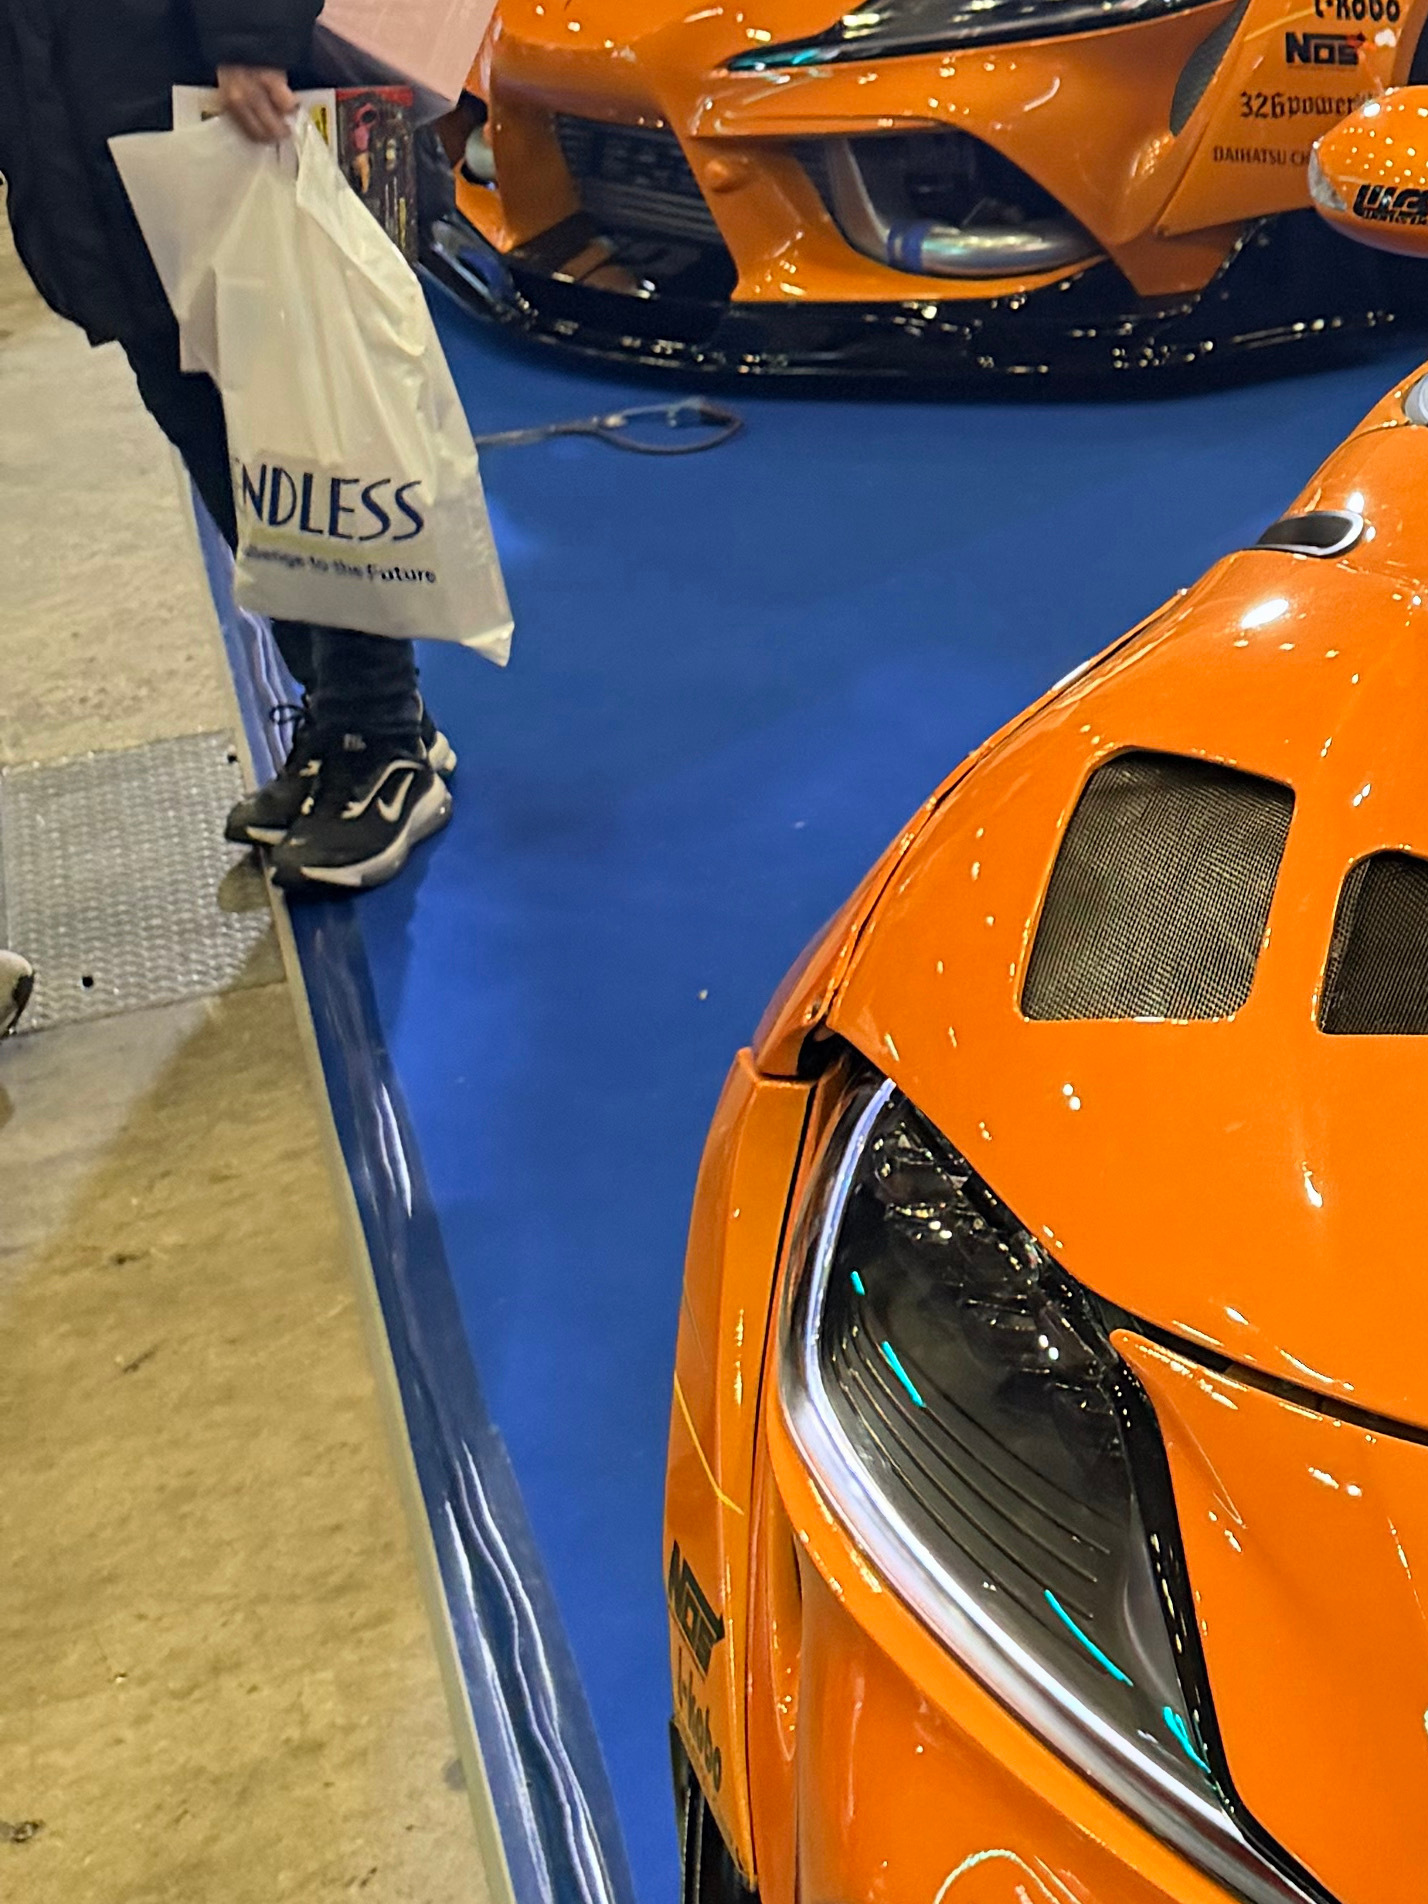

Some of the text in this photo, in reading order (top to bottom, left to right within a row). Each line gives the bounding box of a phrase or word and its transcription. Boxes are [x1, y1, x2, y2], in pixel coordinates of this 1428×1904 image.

[1285, 32, 1360, 65] NOS
[1213, 146, 1288, 166] DAIHATSU
[237, 462, 425, 542] NDLESS
[366, 563, 437, 584] Future
